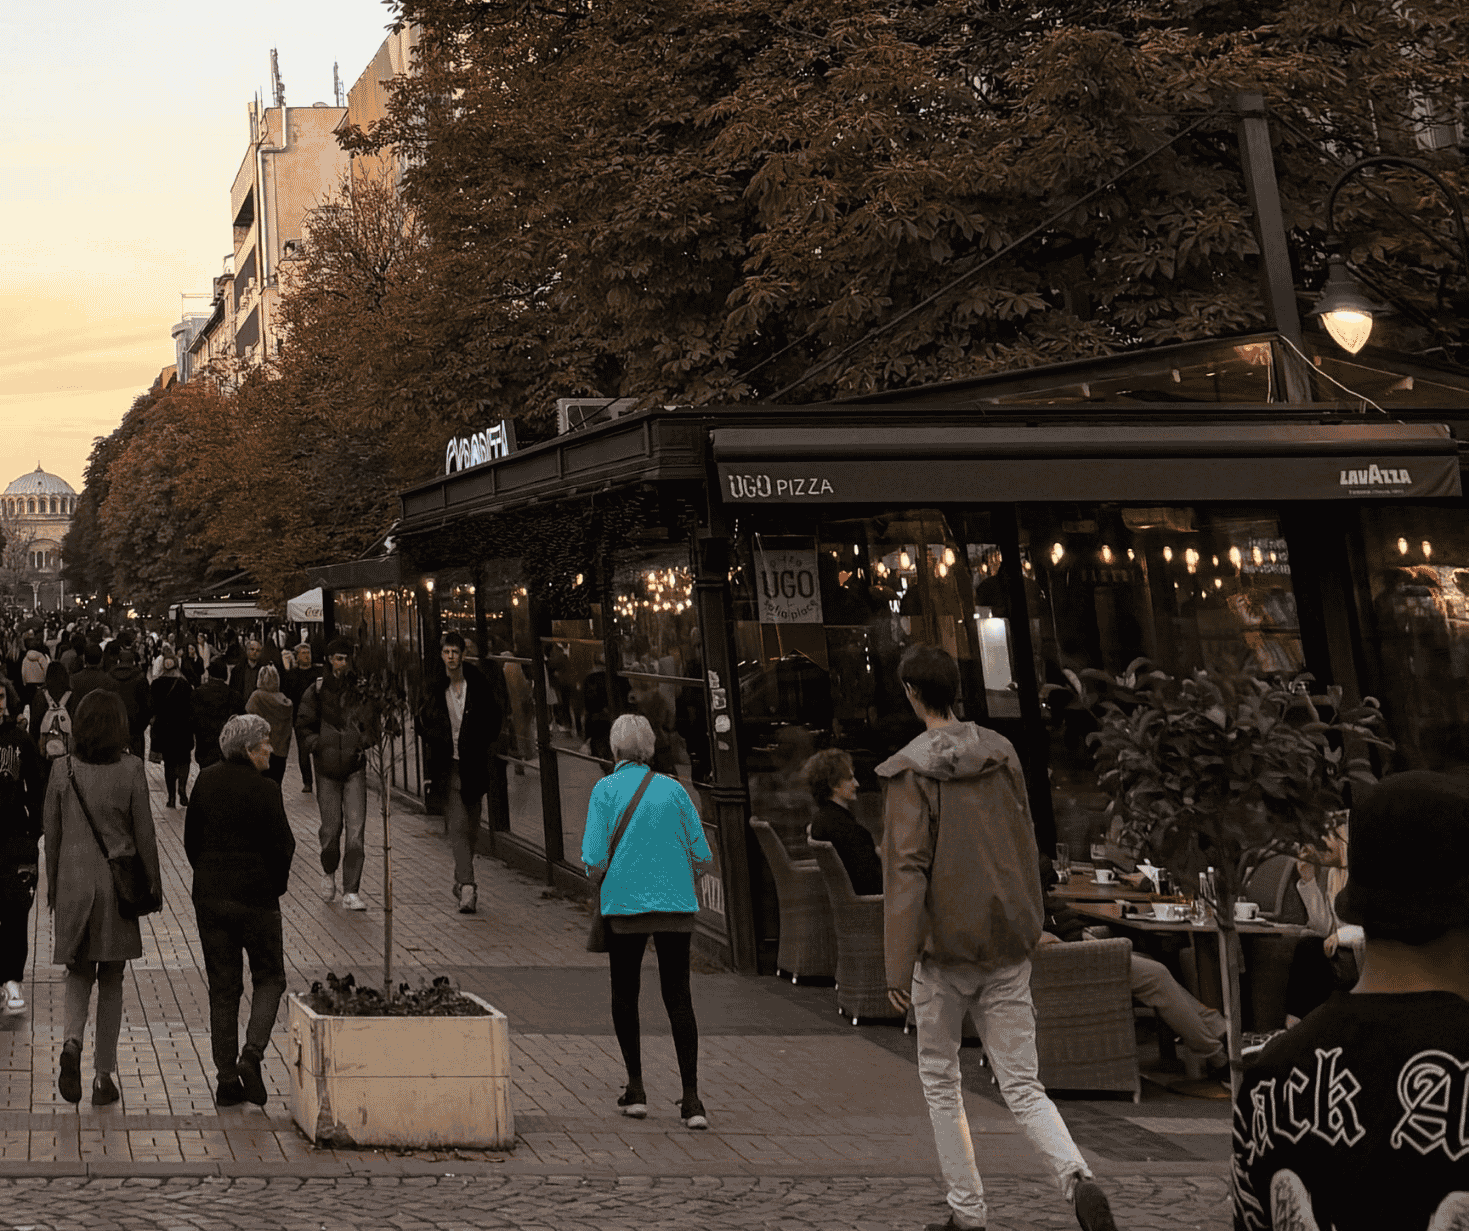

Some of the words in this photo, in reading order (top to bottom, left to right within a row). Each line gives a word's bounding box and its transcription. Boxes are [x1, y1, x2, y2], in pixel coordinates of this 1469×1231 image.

[1339, 464, 1412, 485] LAVAZZA
[728, 475, 771, 498] UGO
[777, 478, 834, 495] PIZZA
[761, 570, 815, 599] UGO
